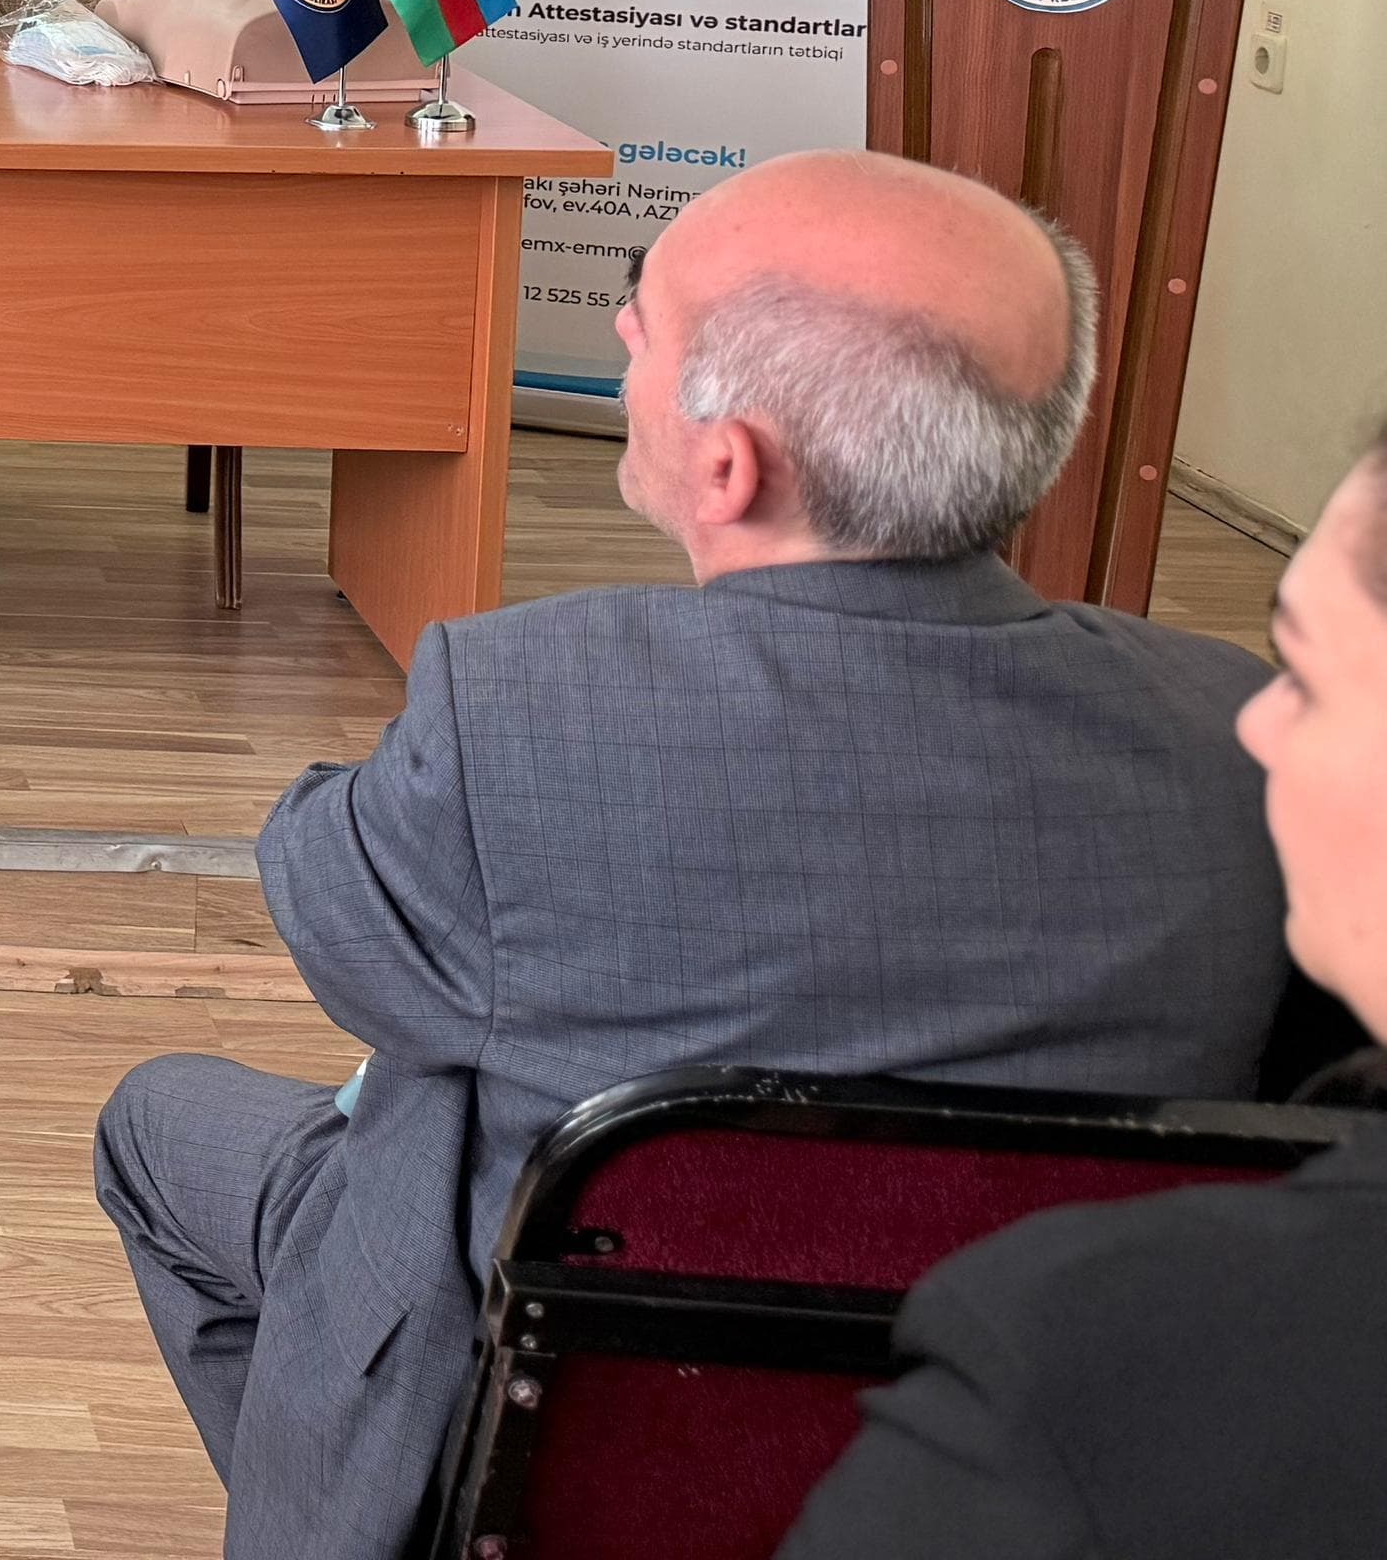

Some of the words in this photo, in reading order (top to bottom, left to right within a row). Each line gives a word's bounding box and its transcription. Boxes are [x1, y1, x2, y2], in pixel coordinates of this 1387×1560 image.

[527, 1, 683, 29] Attestasiyası
[688, 14, 718, 29] və
[724, 13, 866, 38] standartlar
[573, 33, 593, 45] və
[596, 32, 609, 47] iş
[611, 34, 674, 50] yerində
[676, 37, 783, 56] standartların
[788, 43, 843, 62] tətbiqi
[618, 139, 746, 168] gələcək!
[522, 176, 553, 191] akı
[557, 178, 621, 196] şəhəri
[523, 194, 557, 213] fov,
[522, 285, 543, 301] 12
[545, 288, 582, 304] 525
[585, 291, 610, 307] 55
